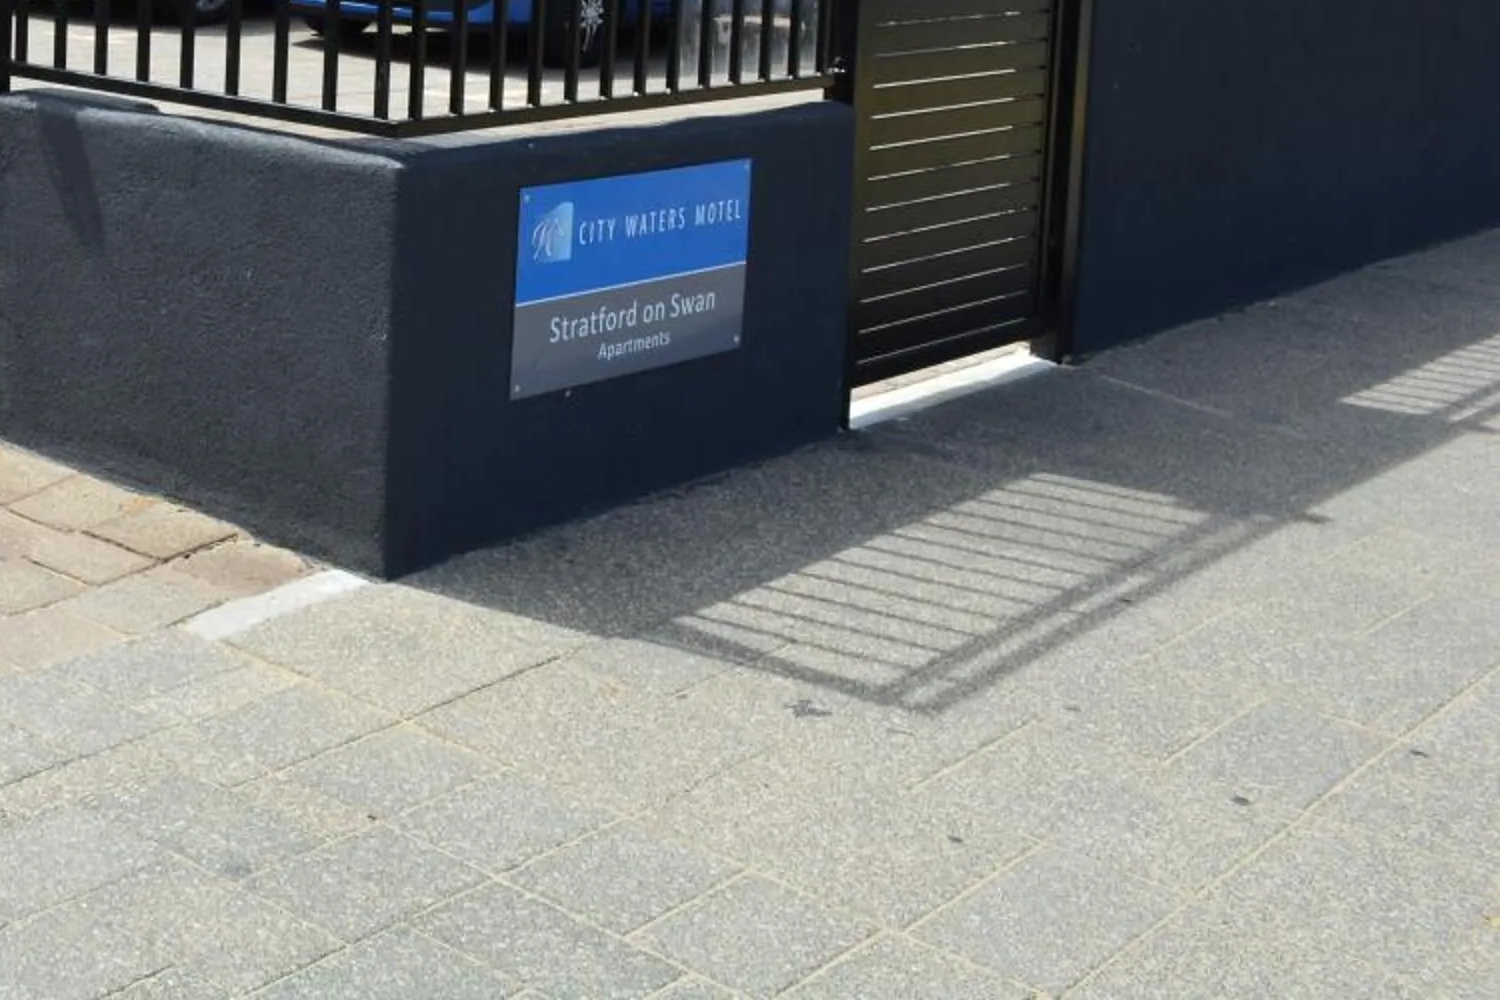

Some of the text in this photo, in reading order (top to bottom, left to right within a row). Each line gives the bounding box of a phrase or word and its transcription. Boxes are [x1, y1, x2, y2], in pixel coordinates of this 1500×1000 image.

[579, 199, 741, 245] CITY WATERS MOTEL
[549, 292, 716, 343] Stratford on Swan
[597, 331, 671, 361] Apartments
